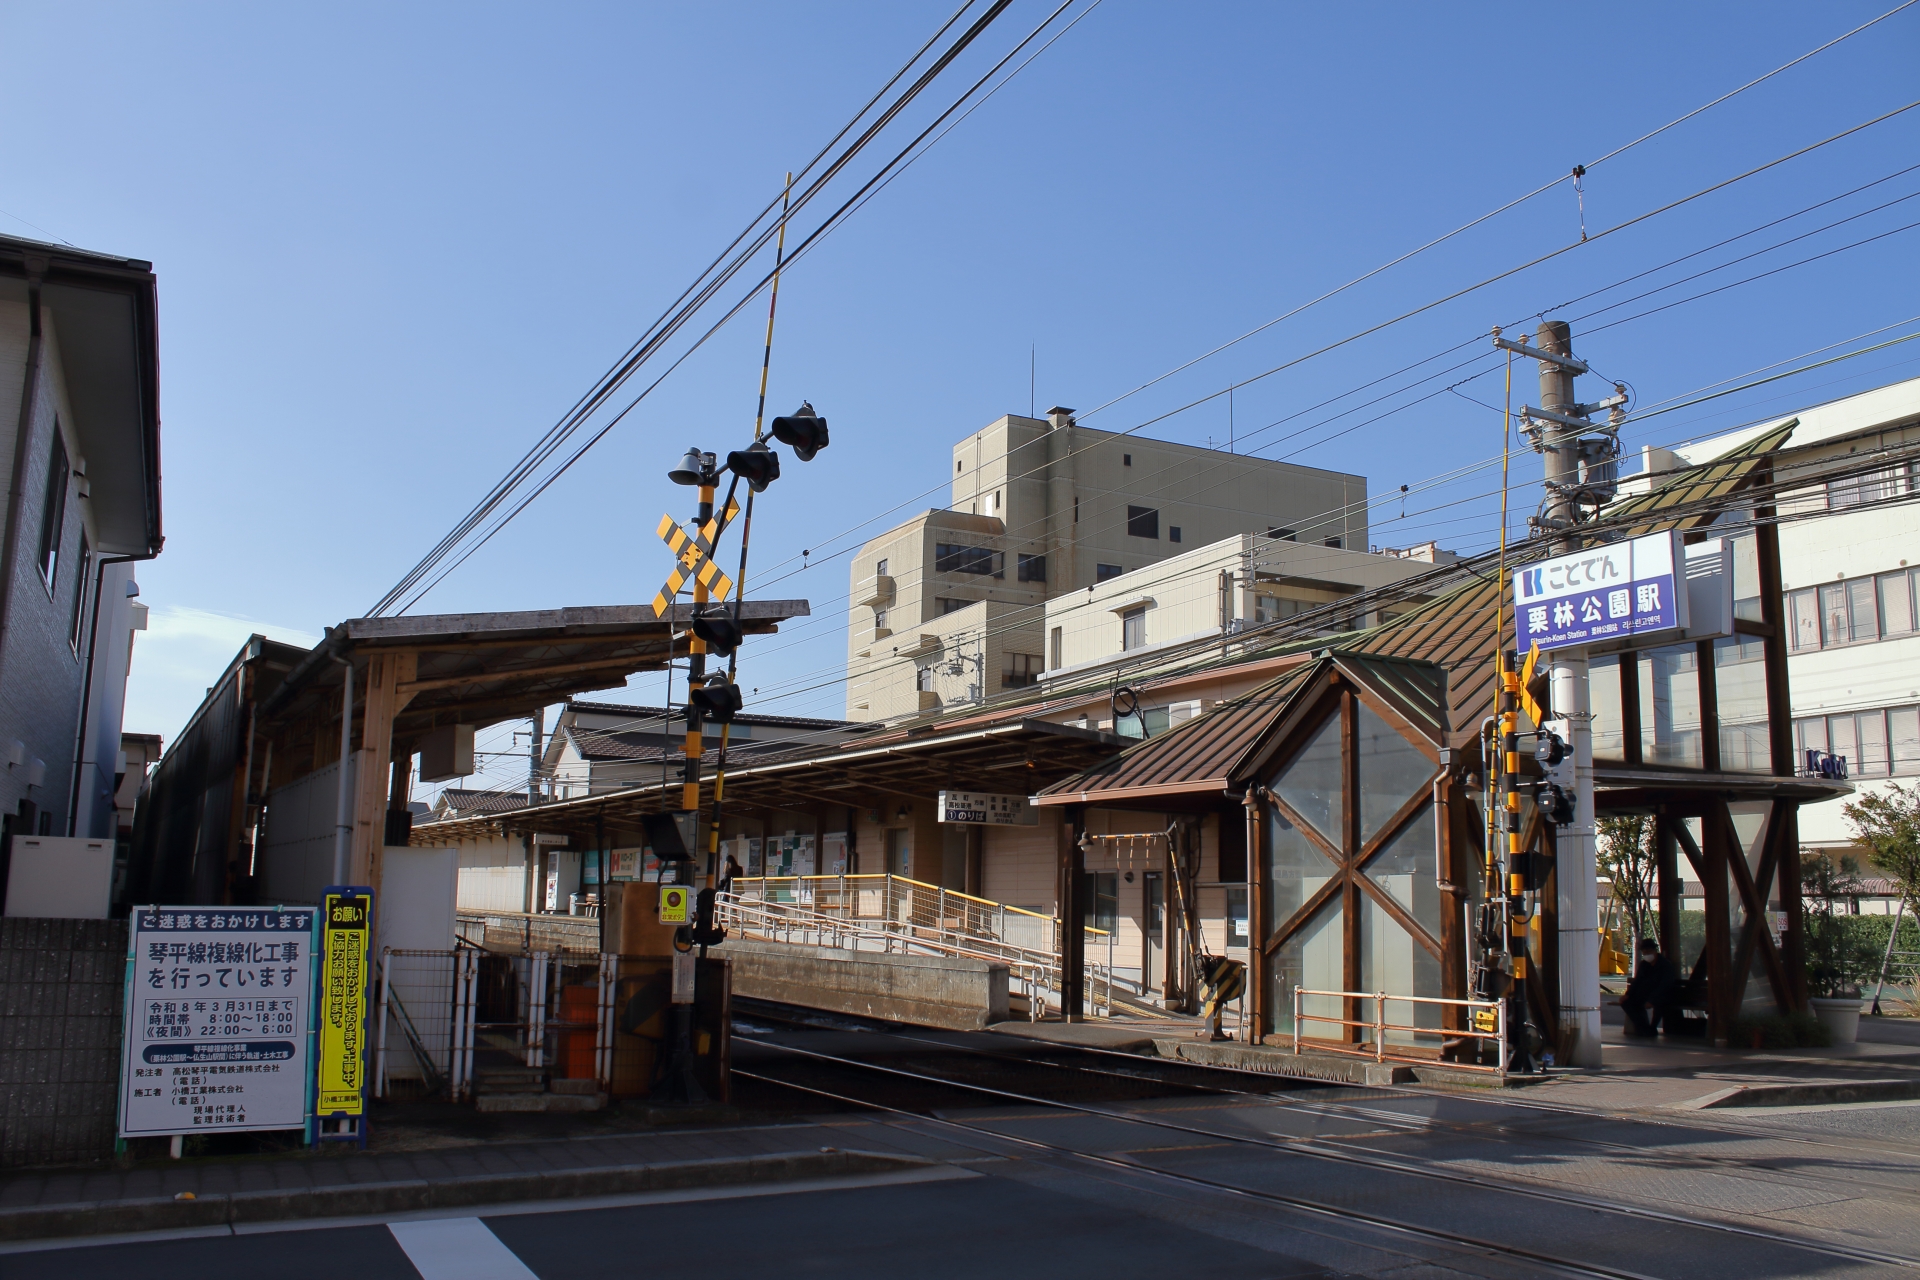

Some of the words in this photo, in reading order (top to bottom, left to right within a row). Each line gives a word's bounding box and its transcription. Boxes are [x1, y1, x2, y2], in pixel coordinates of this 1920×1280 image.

[1549, 554, 1619, 590] ことでん
[1527, 582, 1662, 635] 栗林公園駅
[1567, 629, 1587, 640] Station
[143, 914, 309, 929] ご迷惑をおかけします
[332, 906, 363, 922] お願い
[148, 942, 300, 964] 琴平線複線化工事
[147, 966, 298, 989] を行っています
[330, 931, 346, 1028] ご協力お願い致します。
[149, 1013, 190, 1025] 時間帯
[135, 1068, 164, 1077] 発注者
[172, 1064, 281, 1076] 高松琴平電気鉄道株式会社
[134, 1088, 163, 1097] 施工者
[171, 1085, 244, 1096] 小橋工業株式会社
[193, 1104, 246, 1114] 現場代理人
[193, 1113, 246, 1124] 監理技術者
